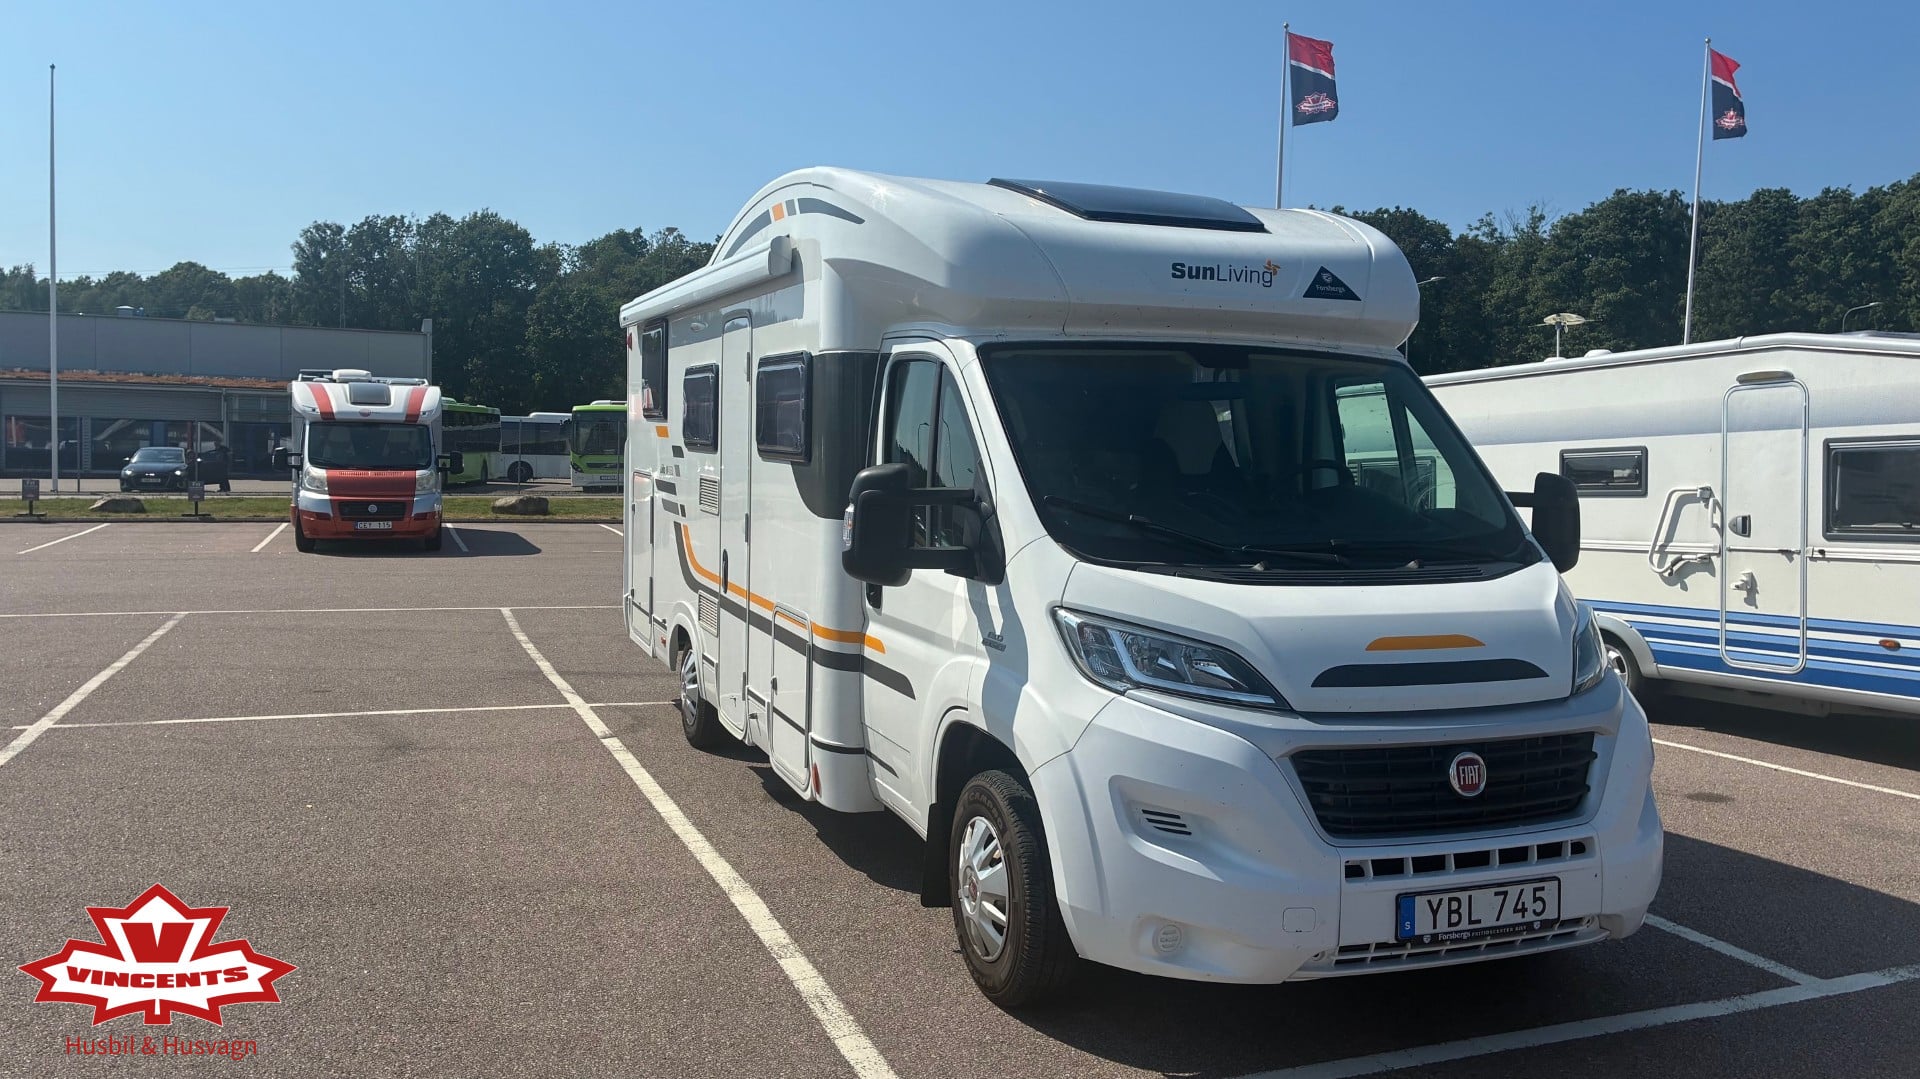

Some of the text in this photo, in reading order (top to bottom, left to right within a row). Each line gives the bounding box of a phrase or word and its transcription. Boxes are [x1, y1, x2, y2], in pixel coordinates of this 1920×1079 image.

[1171, 261, 1273, 289] SunLiving
[1458, 764, 1480, 785] FIAT
[1426, 886, 1547, 930] YBL 745
[1404, 921, 1411, 931] S
[1438, 930, 1471, 941] Forsbergs
